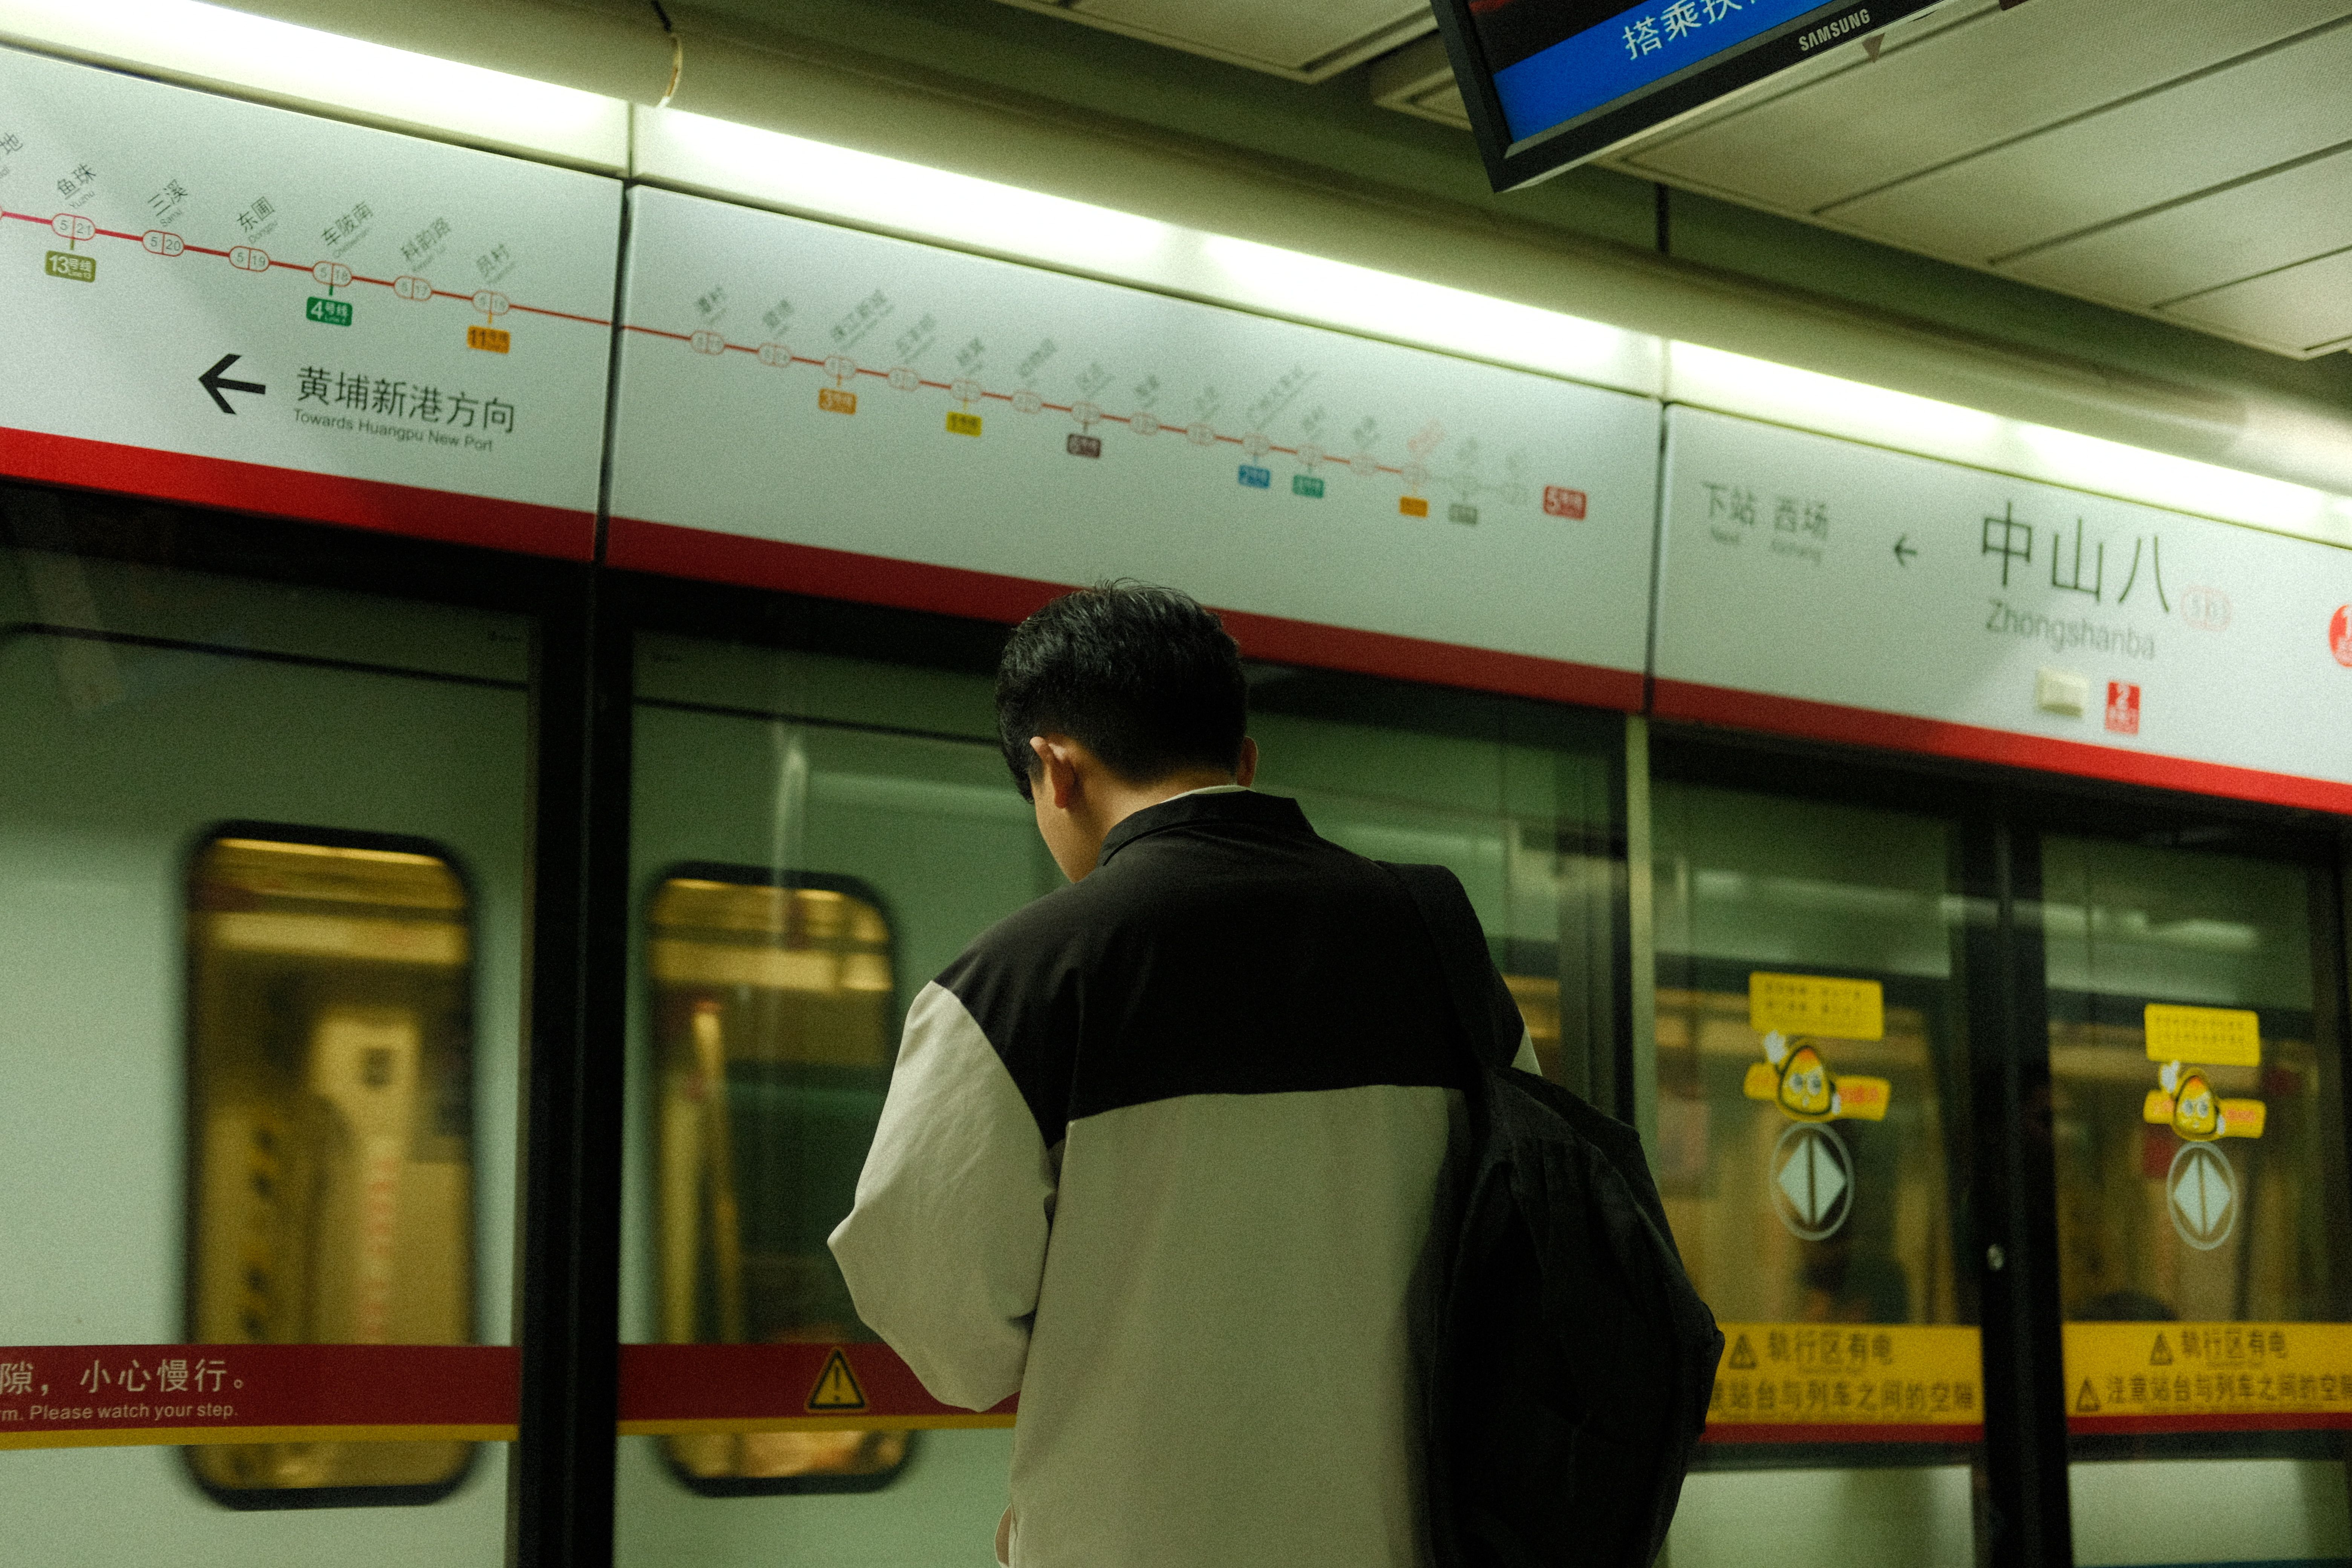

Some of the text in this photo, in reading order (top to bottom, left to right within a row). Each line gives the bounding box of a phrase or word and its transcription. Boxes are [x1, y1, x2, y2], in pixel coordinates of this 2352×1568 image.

[1623, 0, 1756, 60] 搭乘扶
[1799, 9, 1870, 51] SAMSUNG
[58, 164, 96, 200] 鱼珠
[148, 179, 188, 217] 三溪
[60, 220, 91, 235] 5 21
[237, 196, 275, 232] 东圃
[322, 201, 374, 246] 车陂南
[49, 254, 91, 274] 13号线
[151, 236, 181, 252] 5 20
[297, 366, 514, 433] 黄埔新港方向
[294, 408, 492, 452] Towards Huangpu New Port
[1983, 501, 2170, 613] 中山八
[1985, 599, 2155, 660] Zhongshanba
[30, 1405, 93, 1420] Please
[98, 1404, 150, 1418] watch
[155, 1406, 193, 1421] your
[197, 1403, 238, 1419] step.
